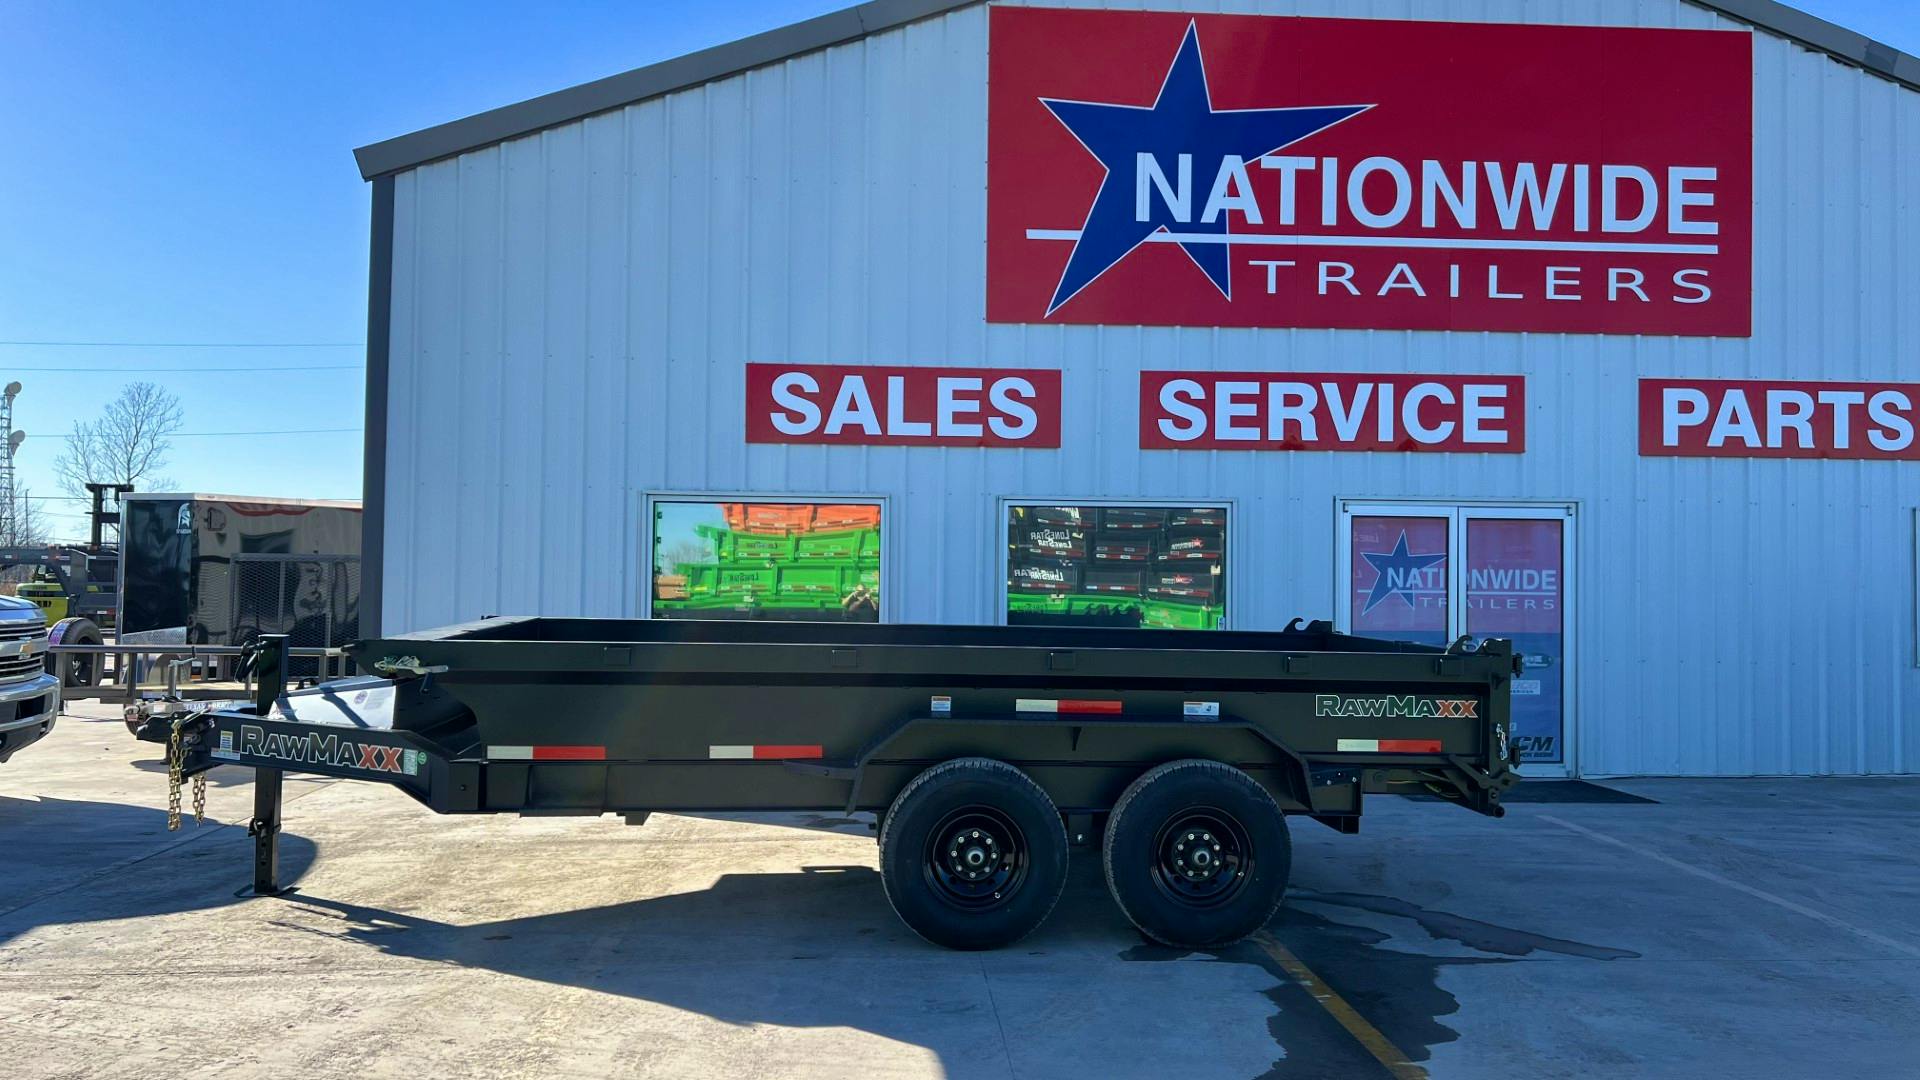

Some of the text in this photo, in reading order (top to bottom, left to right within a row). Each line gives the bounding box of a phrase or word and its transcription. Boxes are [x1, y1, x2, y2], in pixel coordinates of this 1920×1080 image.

[1136, 152, 1719, 235] NATIONWIDE
[1249, 260, 1713, 303] TRAILERS
[770, 372, 1038, 439] SALES
[1157, 379, 1508, 443] SERVICE
[1663, 388, 1914, 451] PARTS
[1387, 567, 1557, 590] NATINWIDE
